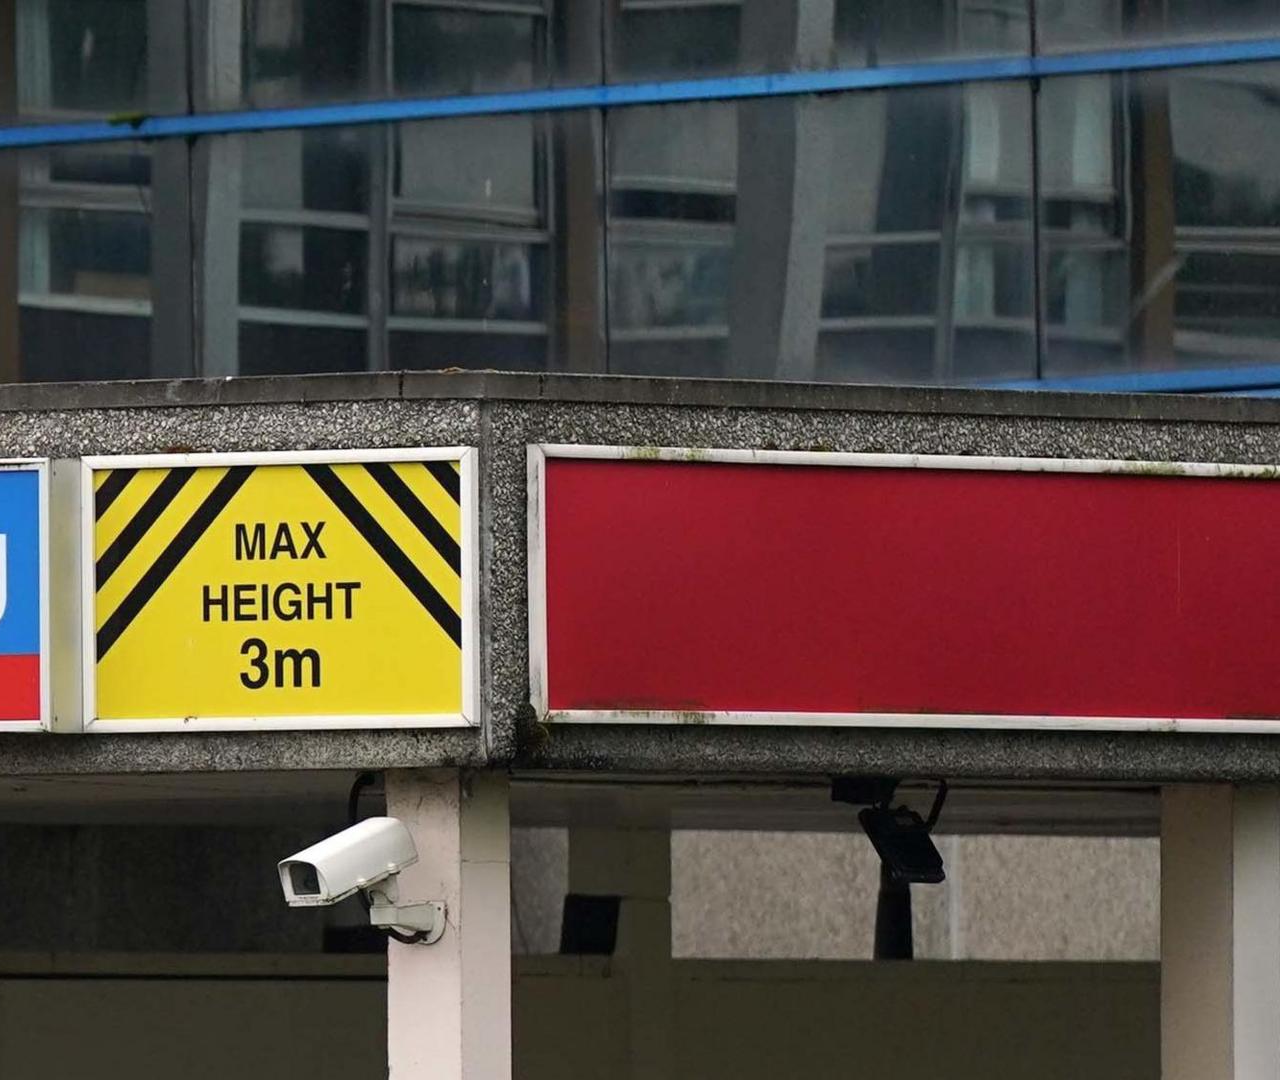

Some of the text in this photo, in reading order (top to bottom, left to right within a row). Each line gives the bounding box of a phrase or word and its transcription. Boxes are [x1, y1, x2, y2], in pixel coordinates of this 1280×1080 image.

[234, 520, 327, 561] MAX
[202, 581, 362, 622] HEIGHT
[239, 637, 322, 690] 3m
